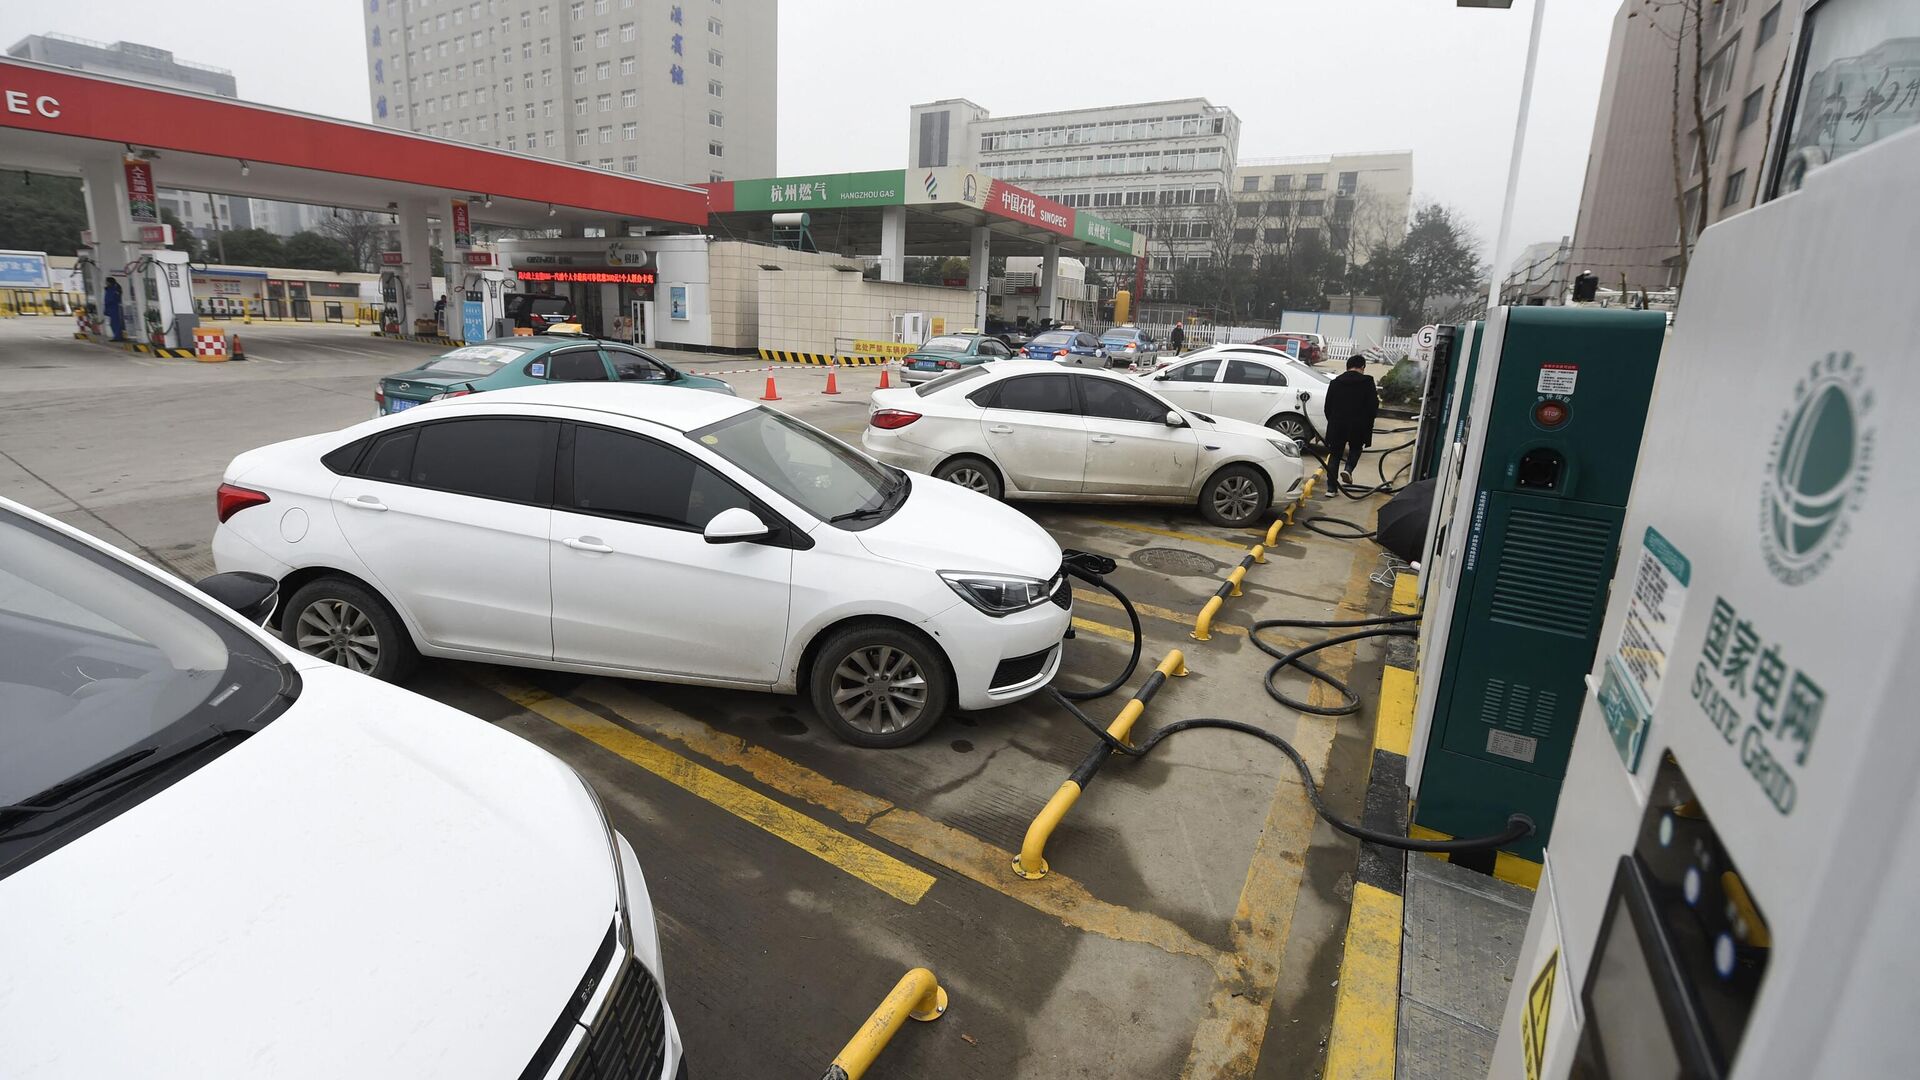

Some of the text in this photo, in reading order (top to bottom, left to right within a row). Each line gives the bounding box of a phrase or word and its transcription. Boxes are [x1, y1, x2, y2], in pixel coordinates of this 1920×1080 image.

[5, 89, 61, 119] EC
[770, 182, 827, 203] 杭州燃气
[840, 189, 895, 200] HANGZHOU GAS
[1001, 190, 1036, 218] 中国石化
[1040, 209, 1068, 229] SINOPEC
[1088, 221, 1112, 242] 杭州燃气
[855, 343, 883, 353] 此处严禁
[1423, 332, 1432, 344] 5
[1702, 595, 1828, 768] 国家电网
[1691, 661, 1742, 746] STATE
[581, 978, 595, 1003] BYD
